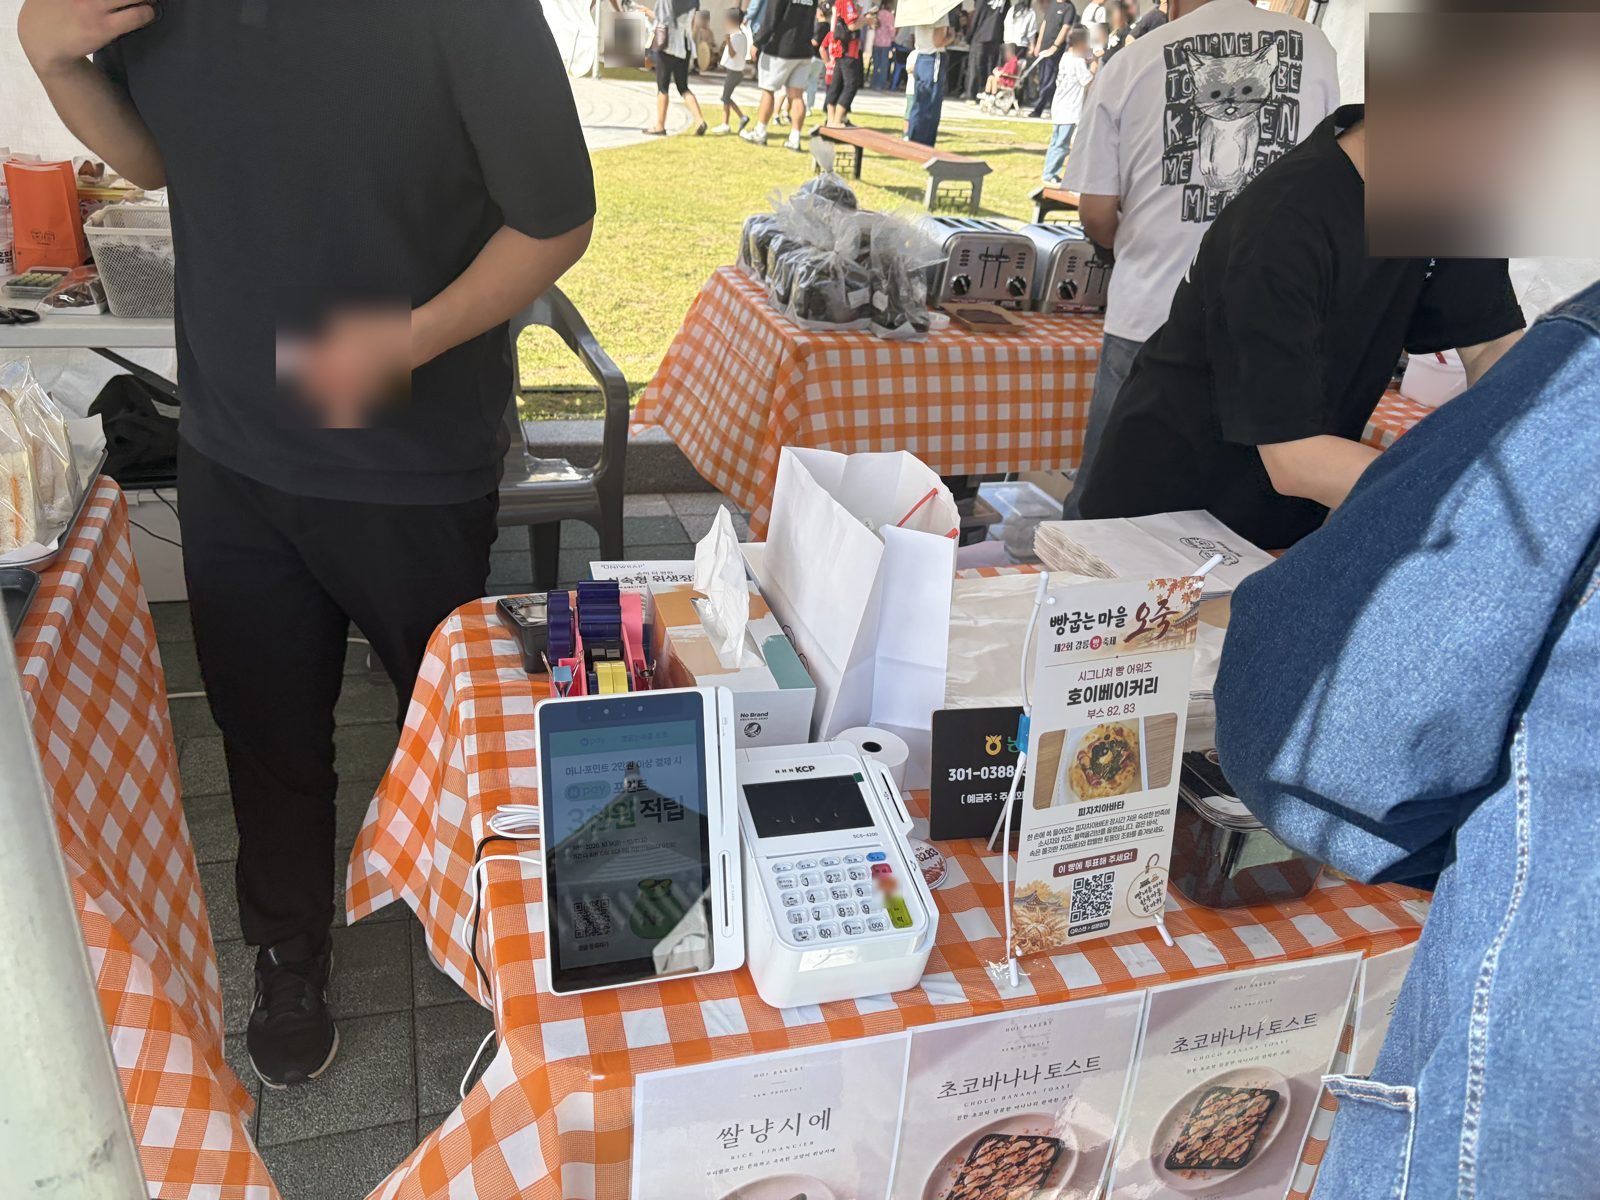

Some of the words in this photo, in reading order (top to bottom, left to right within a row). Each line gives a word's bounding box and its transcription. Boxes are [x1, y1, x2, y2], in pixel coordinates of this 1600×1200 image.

[1276, 62, 1302, 91] BE
[1164, 102, 1299, 149] KIEN
[1162, 155, 1192, 184] ME
[653, 574, 694, 583] 위생장
[1050, 611, 1095, 636] 빵굽는
[1098, 606, 1128, 628] 마을
[1124, 598, 1179, 643] 오죽
[1053, 641, 1073, 653] 제2회
[1078, 667, 1113, 682] 시그니처
[1115, 665, 1124, 677] 빵
[1127, 662, 1152, 675] 어워즈
[1066, 676, 1158, 706] 호이베이커리
[1087, 708, 1104, 719] 부스
[1123, 703, 1135, 714] 83
[637, 759, 652, 769] 이상
[655, 756, 671, 768] 결제
[673, 755, 681, 765] 시
[795, 765, 815, 773] KCP
[640, 796, 684, 823] 적립
[967, 793, 992, 804] 예금주
[1078, 800, 1124, 816] 피자치아바타
[1058, 865, 1066, 873] 이
[1085, 857, 1107, 868] 투표해
[1109, 851, 1133, 863] 주세요!
[1170, 1021, 1263, 1054] 초코바나나
[1265, 1013, 1318, 1036] 토스트
[937, 1065, 1041, 1099] 초코바나나
[1044, 1056, 1101, 1080] 토스트
[963, 1097, 996, 1107] CHOCO
[1001, 1090, 1037, 1101] BANANA
[1043, 1083, 1071, 1093] TOAST
[716, 1107, 832, 1149] 쌀냥시에
